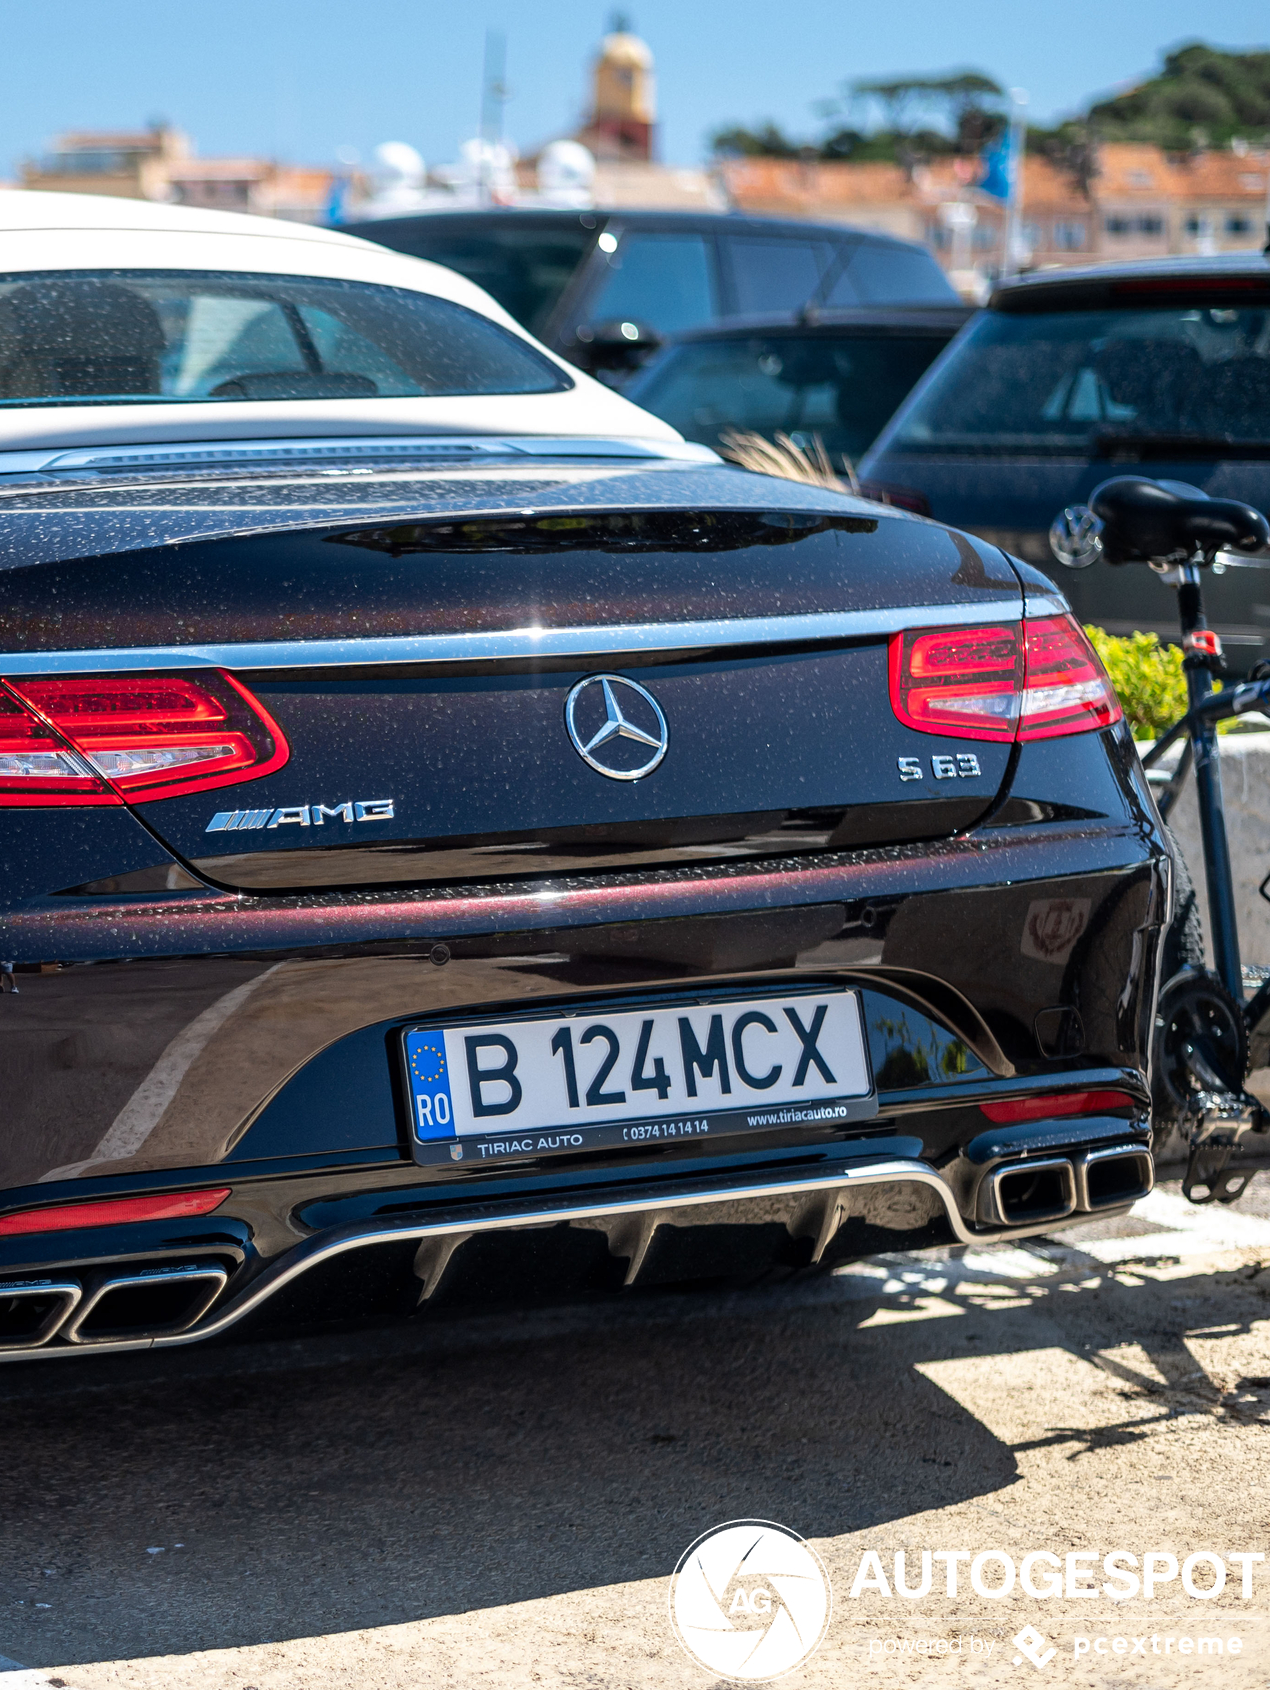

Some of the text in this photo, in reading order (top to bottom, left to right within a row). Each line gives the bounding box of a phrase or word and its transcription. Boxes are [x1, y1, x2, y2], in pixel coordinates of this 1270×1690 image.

[897, 753, 981, 782] S 63
[266, 799, 395, 829] AMG
[464, 1033, 522, 1118] B
[416, 1092, 450, 1127] RO
[747, 1106, 847, 1126] www.tiriacauto.ro
[537, 1134, 583, 1149] AUTO
